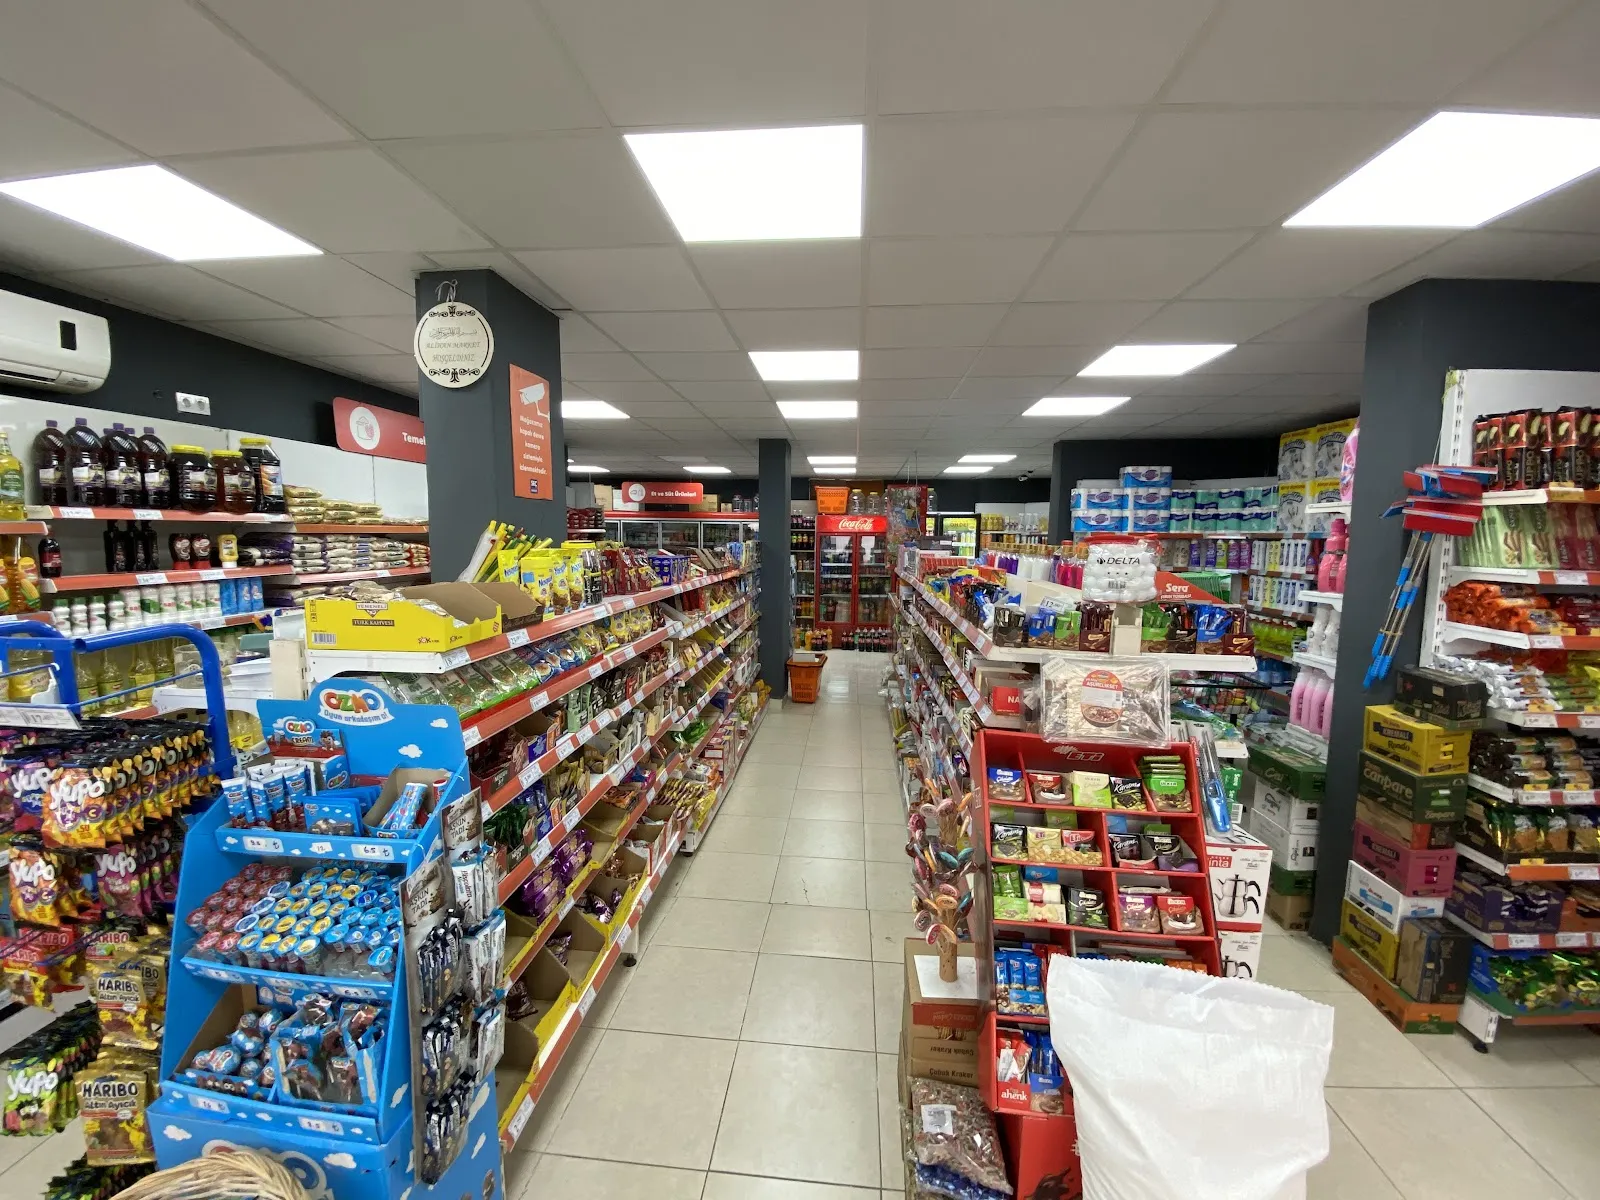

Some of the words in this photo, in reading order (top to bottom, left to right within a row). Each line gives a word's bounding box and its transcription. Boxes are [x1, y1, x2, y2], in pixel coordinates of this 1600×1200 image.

[402, 432, 426, 446] Temel
[1106, 556, 1140, 565] DELTA
[1165, 583, 1190, 593] Sera
[98, 978, 139, 992] HARIBO
[951, 1069, 974, 1079] Kraker
[82, 1081, 139, 1098] HARIBO
[1001, 1089, 1028, 1101] ahenk
